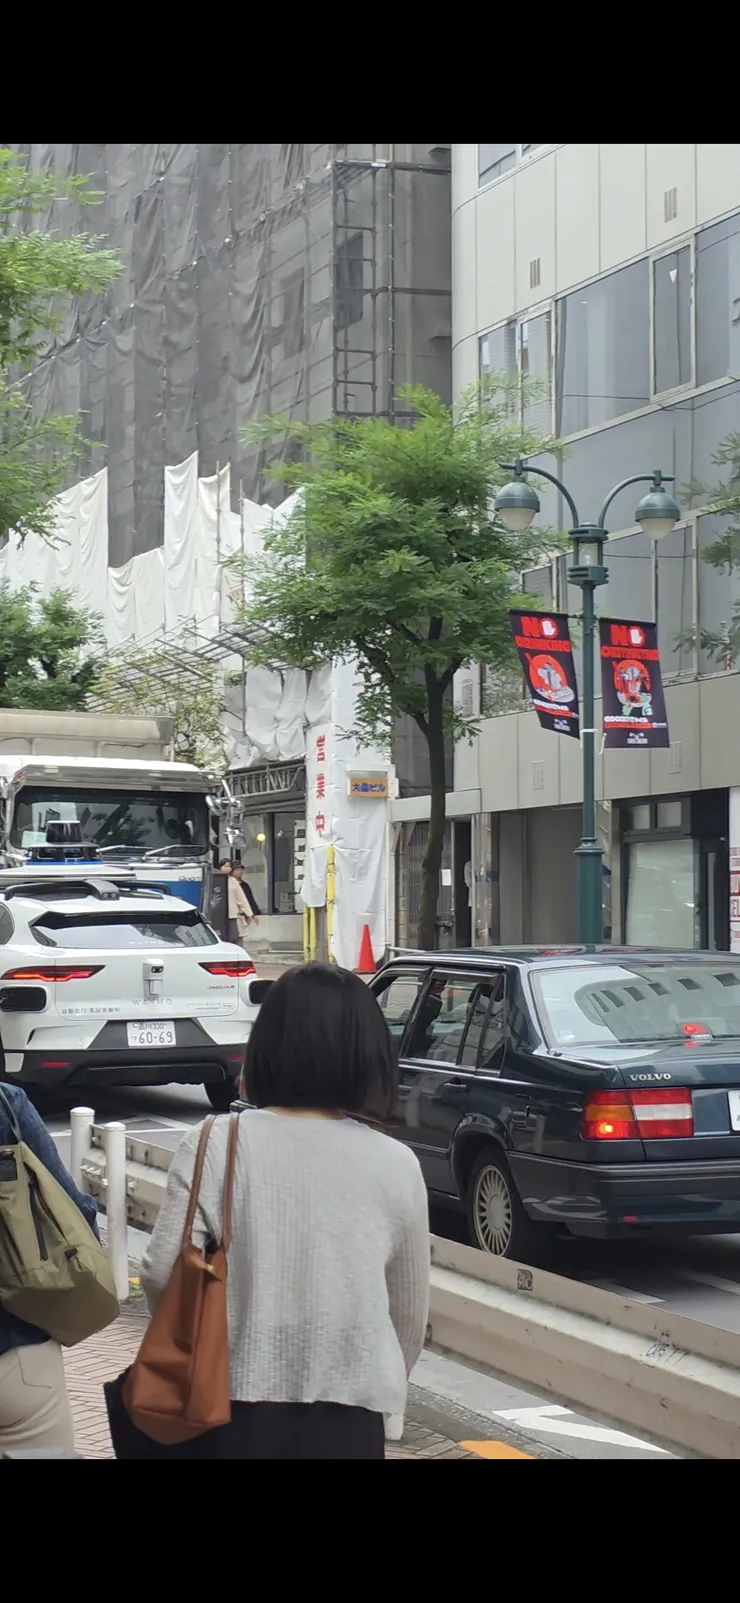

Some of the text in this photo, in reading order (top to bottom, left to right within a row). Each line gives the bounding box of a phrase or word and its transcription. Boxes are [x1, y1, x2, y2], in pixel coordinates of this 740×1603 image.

[520, 616, 559, 639] NO
[610, 624, 647, 648] NO
[138, 1030, 173, 1044] 60-69
[629, 1073, 672, 1082] VOLVO
